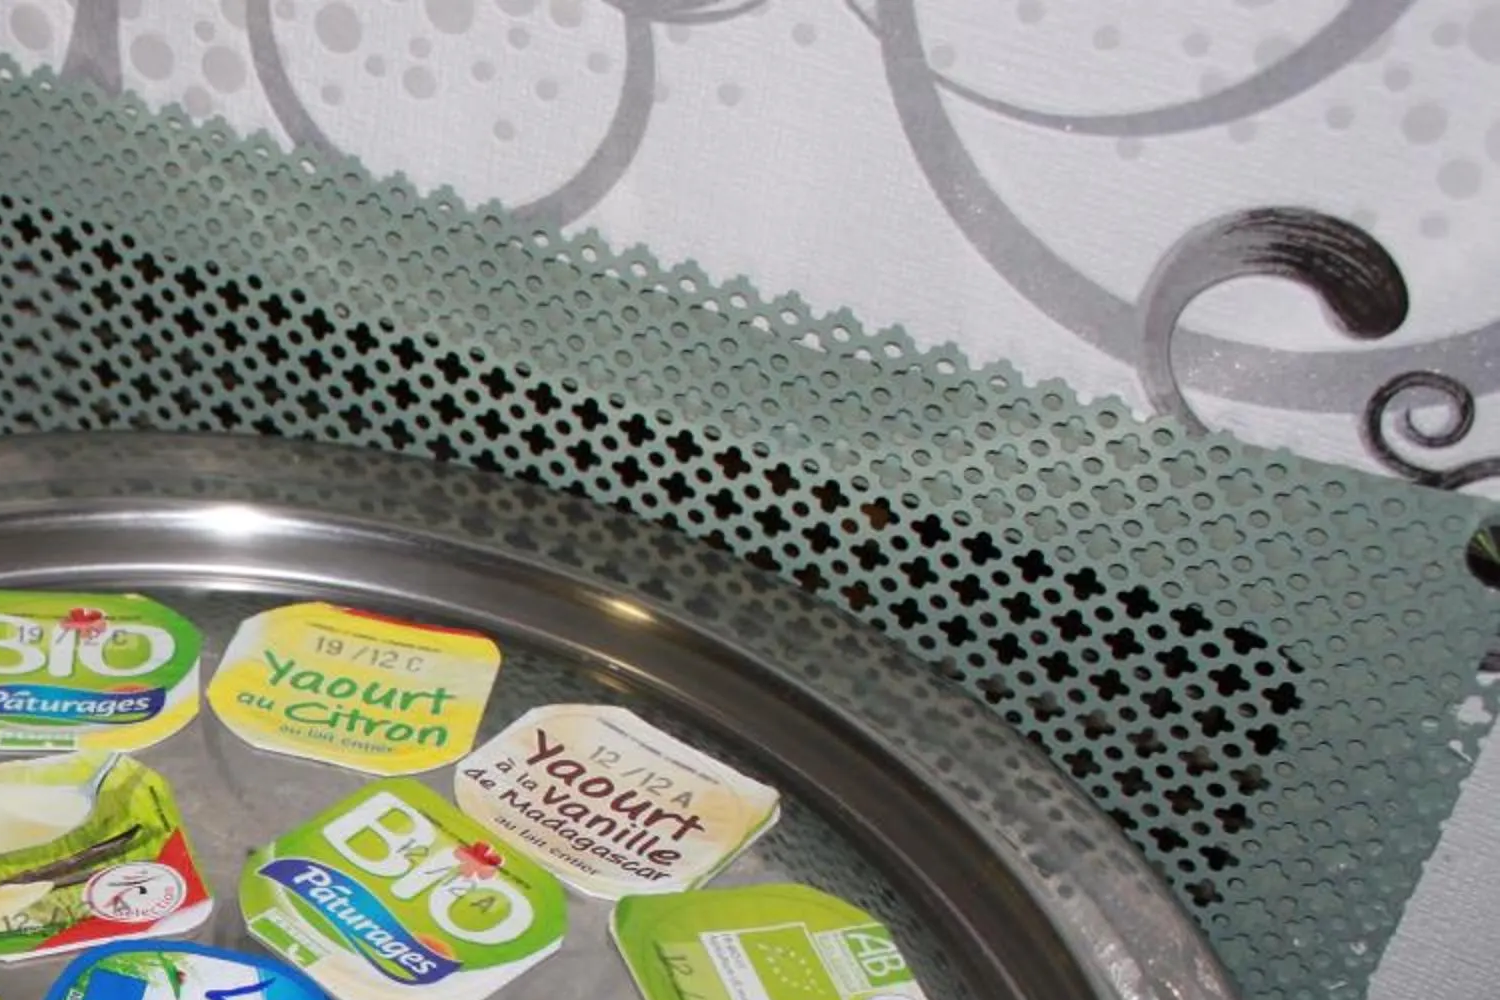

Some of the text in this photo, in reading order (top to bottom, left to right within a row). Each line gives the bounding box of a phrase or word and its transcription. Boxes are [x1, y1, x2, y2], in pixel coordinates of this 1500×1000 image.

[264, 649, 457, 716] Yaourt
[236, 690, 449, 747] au Citron
[495, 756, 517, 774] à
[515, 772, 539, 793] la
[525, 728, 706, 842] Yaourt
[463, 768, 673, 882] de Madagascar
[292, 865, 438, 976] Pâturages
[847, 931, 906, 978] AB
